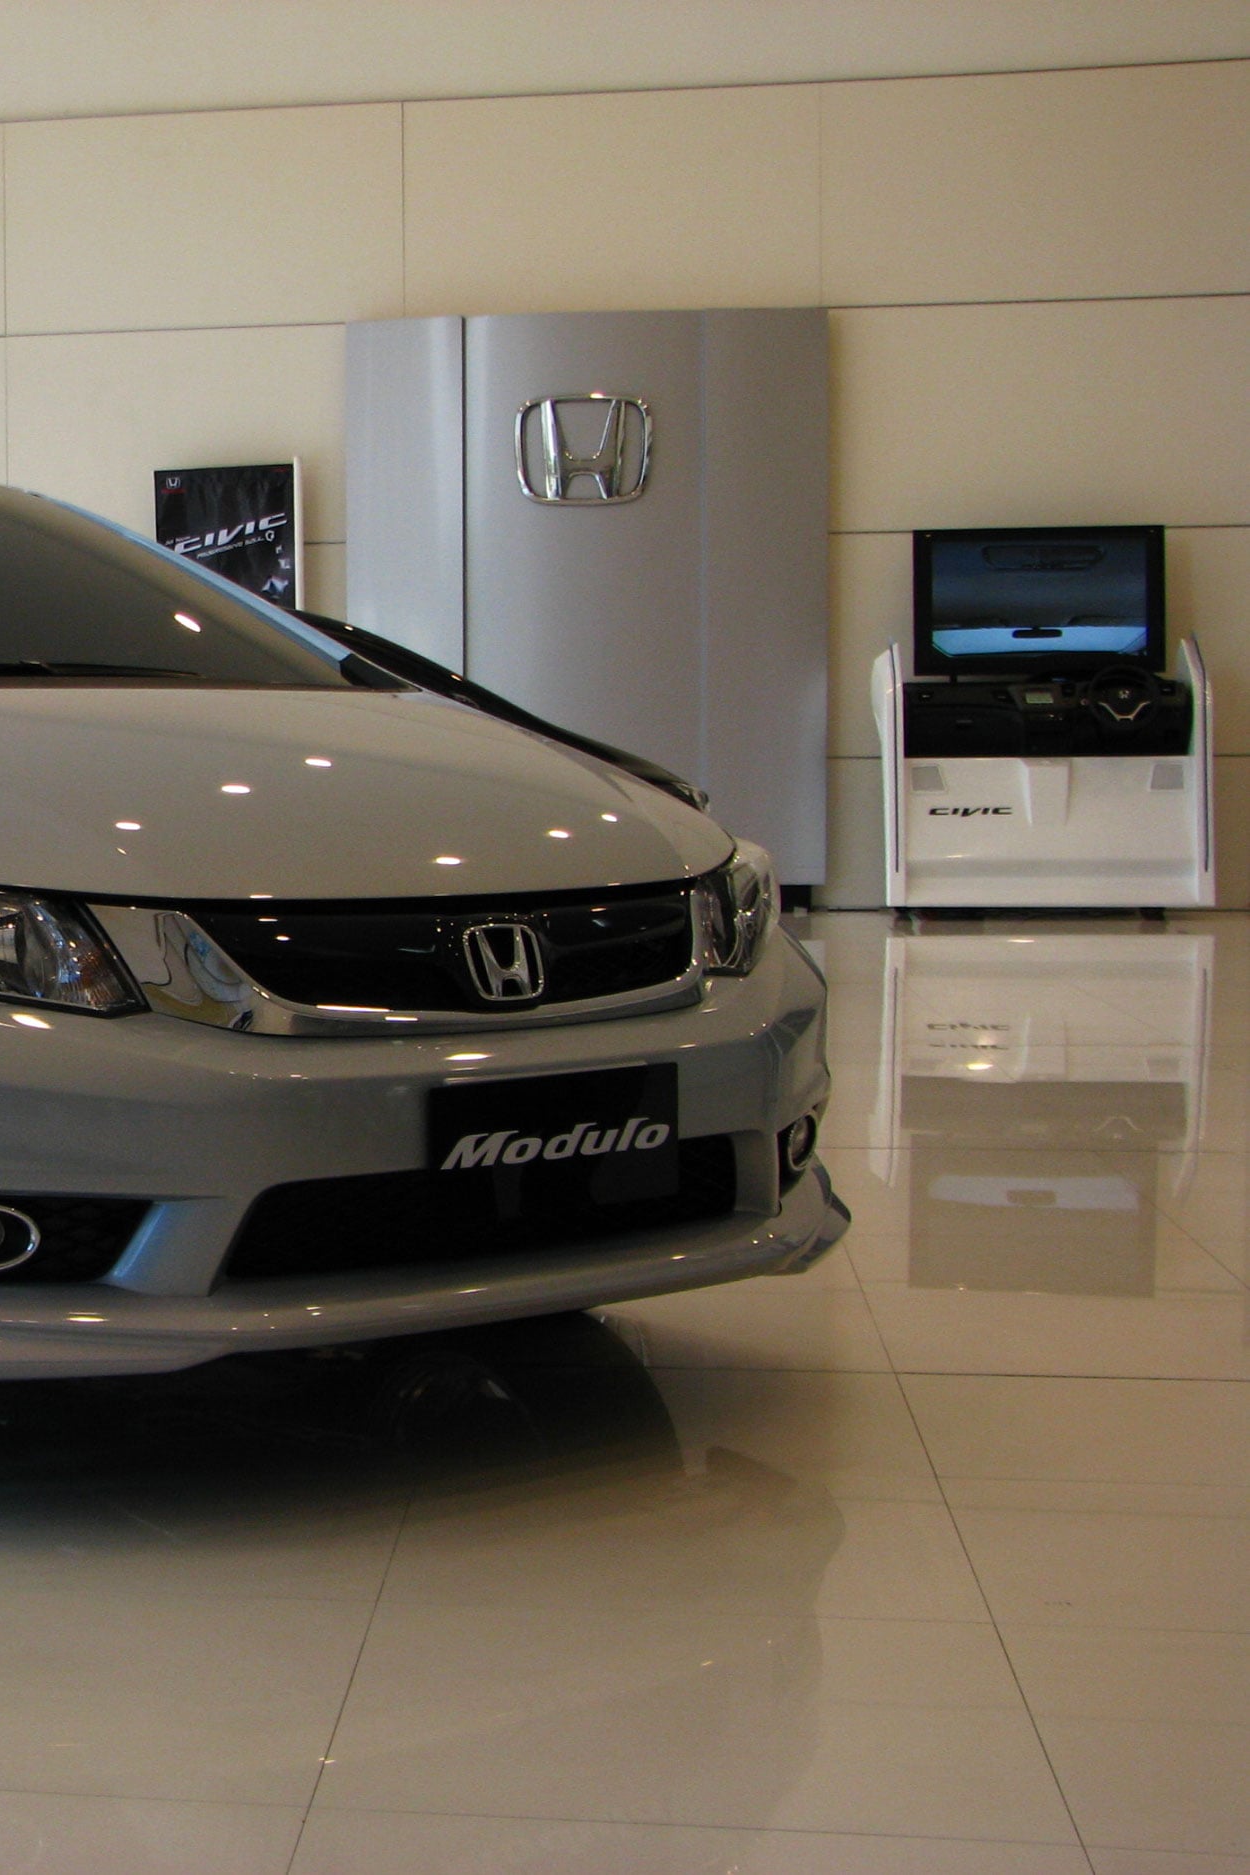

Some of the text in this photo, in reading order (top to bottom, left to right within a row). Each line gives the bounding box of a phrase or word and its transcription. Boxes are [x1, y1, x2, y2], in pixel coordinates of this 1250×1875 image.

[174, 512, 288, 554] CIVIC
[928, 806, 1013, 817] CIVIC
[440, 1117, 670, 1170] Modulo
